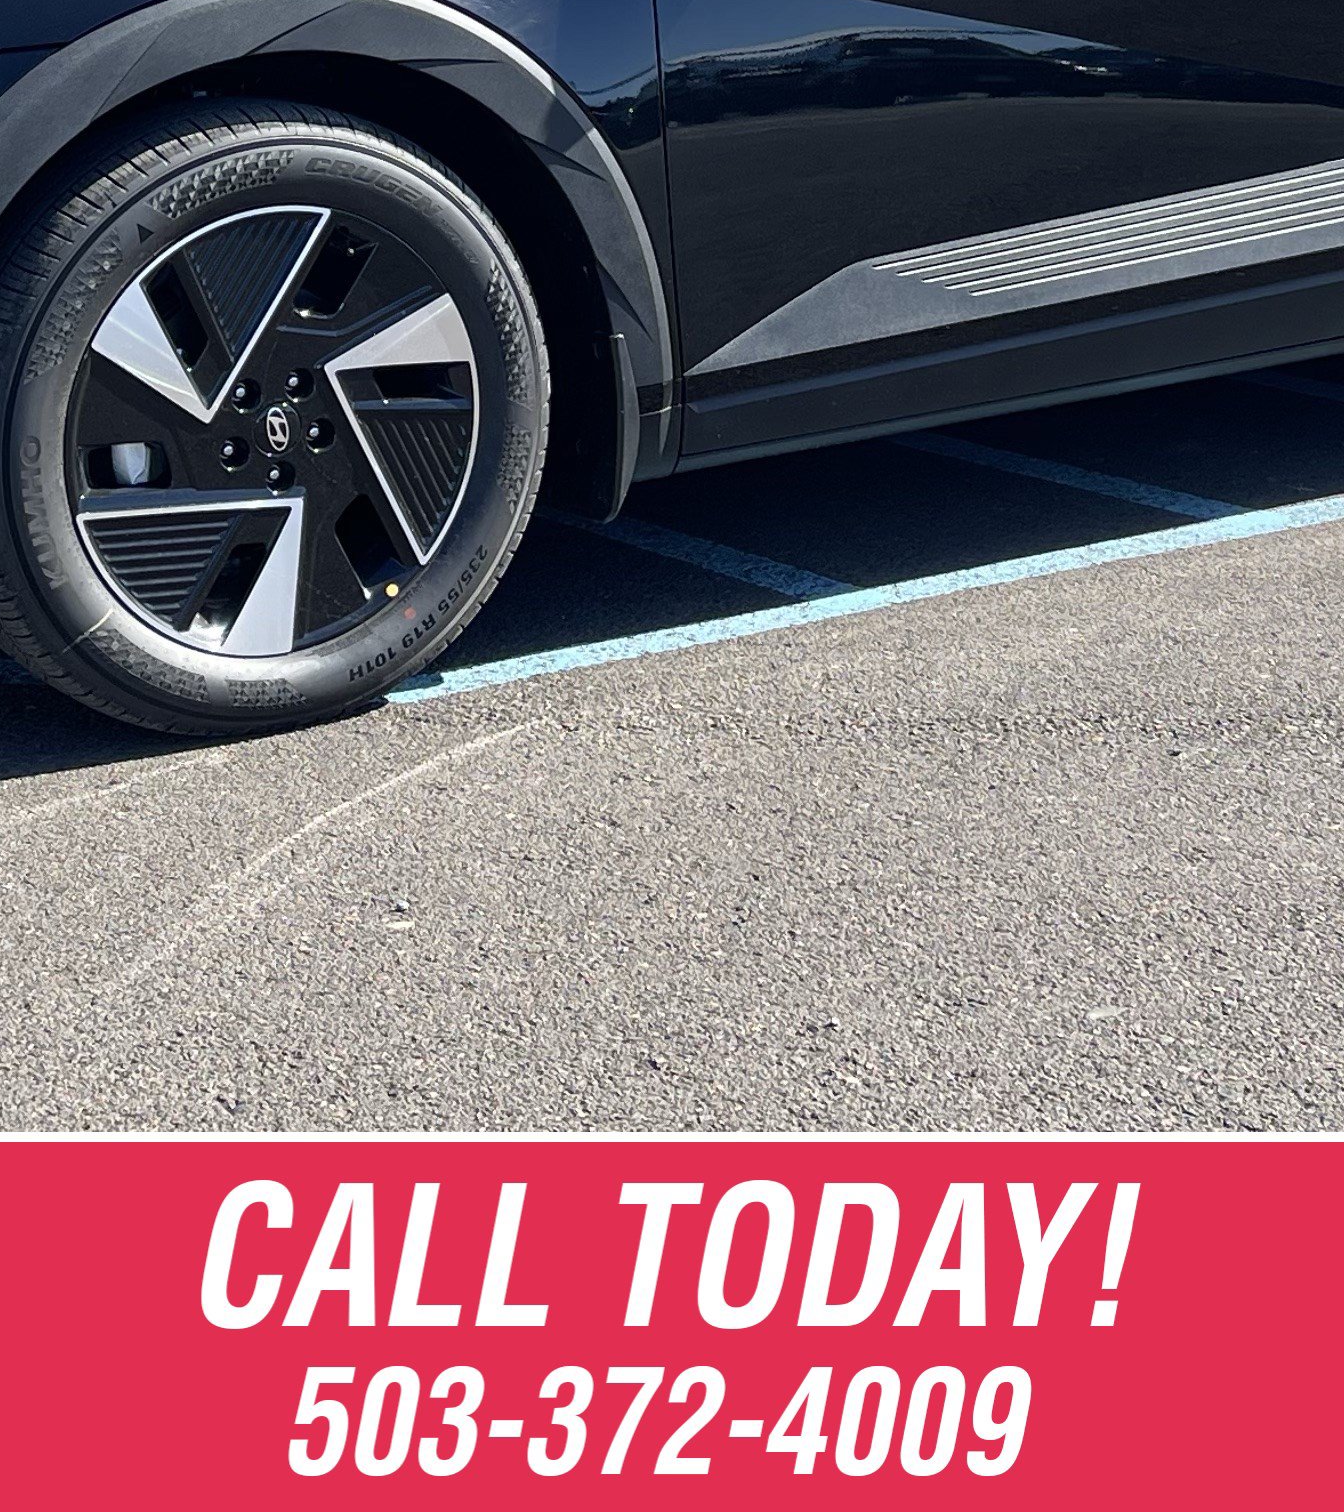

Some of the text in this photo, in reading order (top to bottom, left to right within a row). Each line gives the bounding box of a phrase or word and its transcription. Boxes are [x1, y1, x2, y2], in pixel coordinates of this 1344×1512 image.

[304, 157, 444, 218] CRUGEN
[20, 435, 69, 590] KUMHO
[349, 544, 488, 681] 235/55 R19 101H
